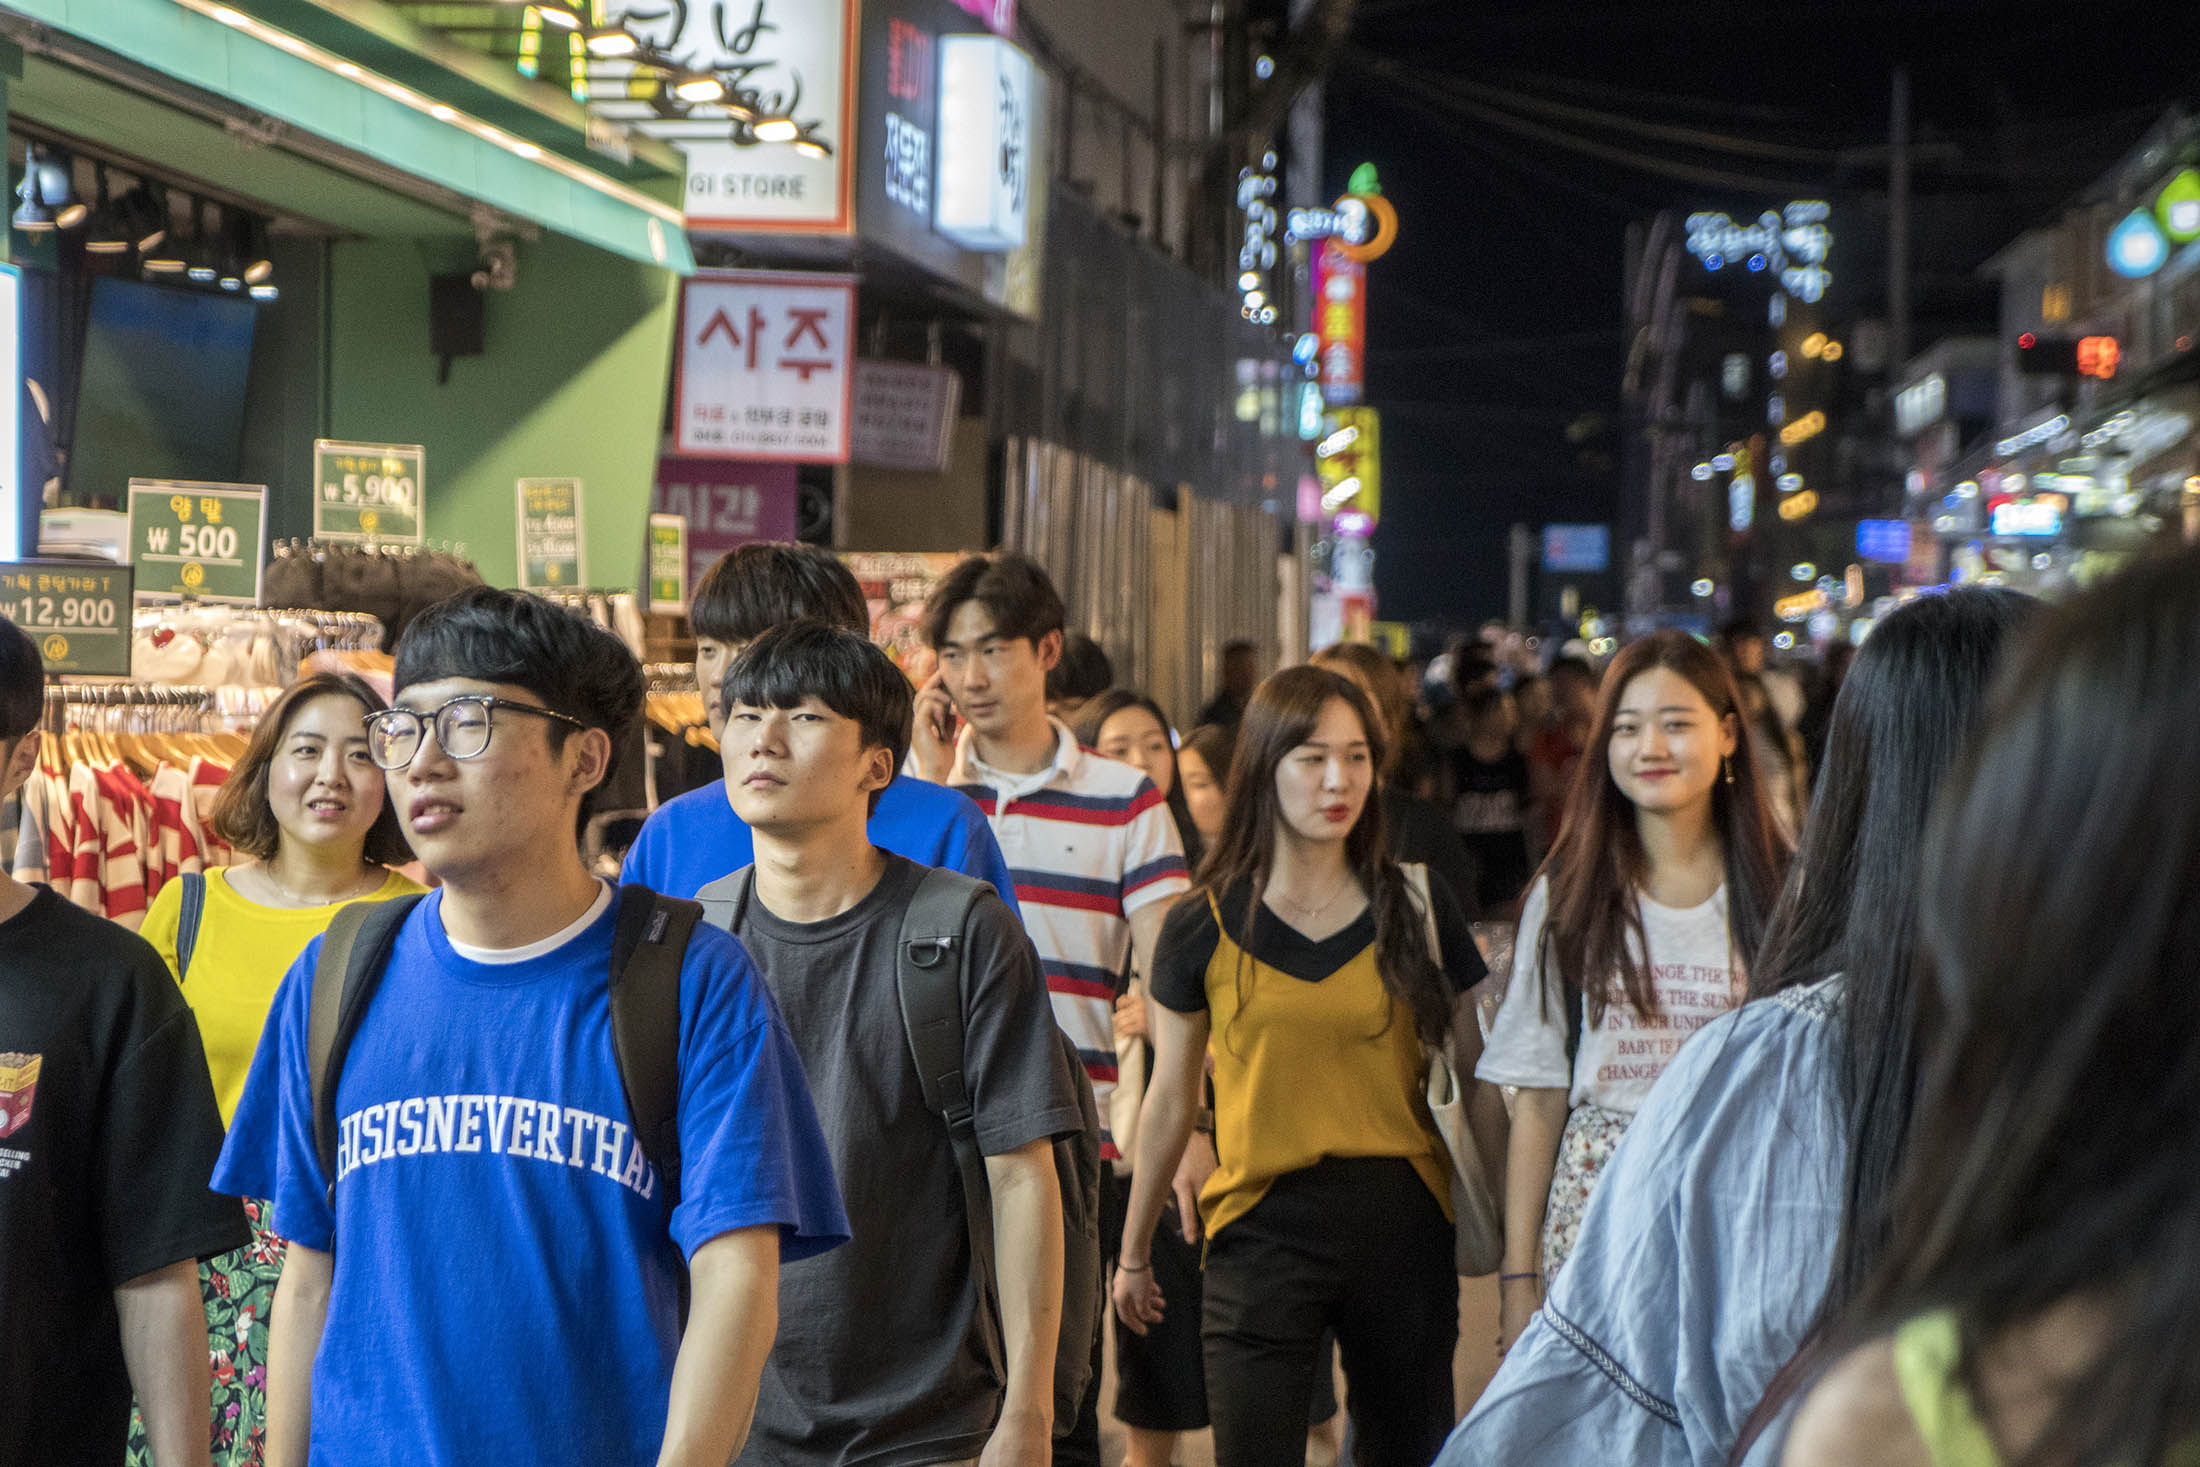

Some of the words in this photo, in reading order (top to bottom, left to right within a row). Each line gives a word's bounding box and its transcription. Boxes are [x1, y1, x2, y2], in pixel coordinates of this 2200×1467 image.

[722, 174, 805, 199] STORE
[697, 304, 833, 381] 사주
[343, 473, 415, 507] 5,900
[178, 523, 239, 559] 500
[21, 596, 116, 629] 12,900
[1608, 1014, 1623, 1031] IN
[1617, 1039, 1654, 1056] BABY
[1597, 1063, 1660, 1082] CHANGE
